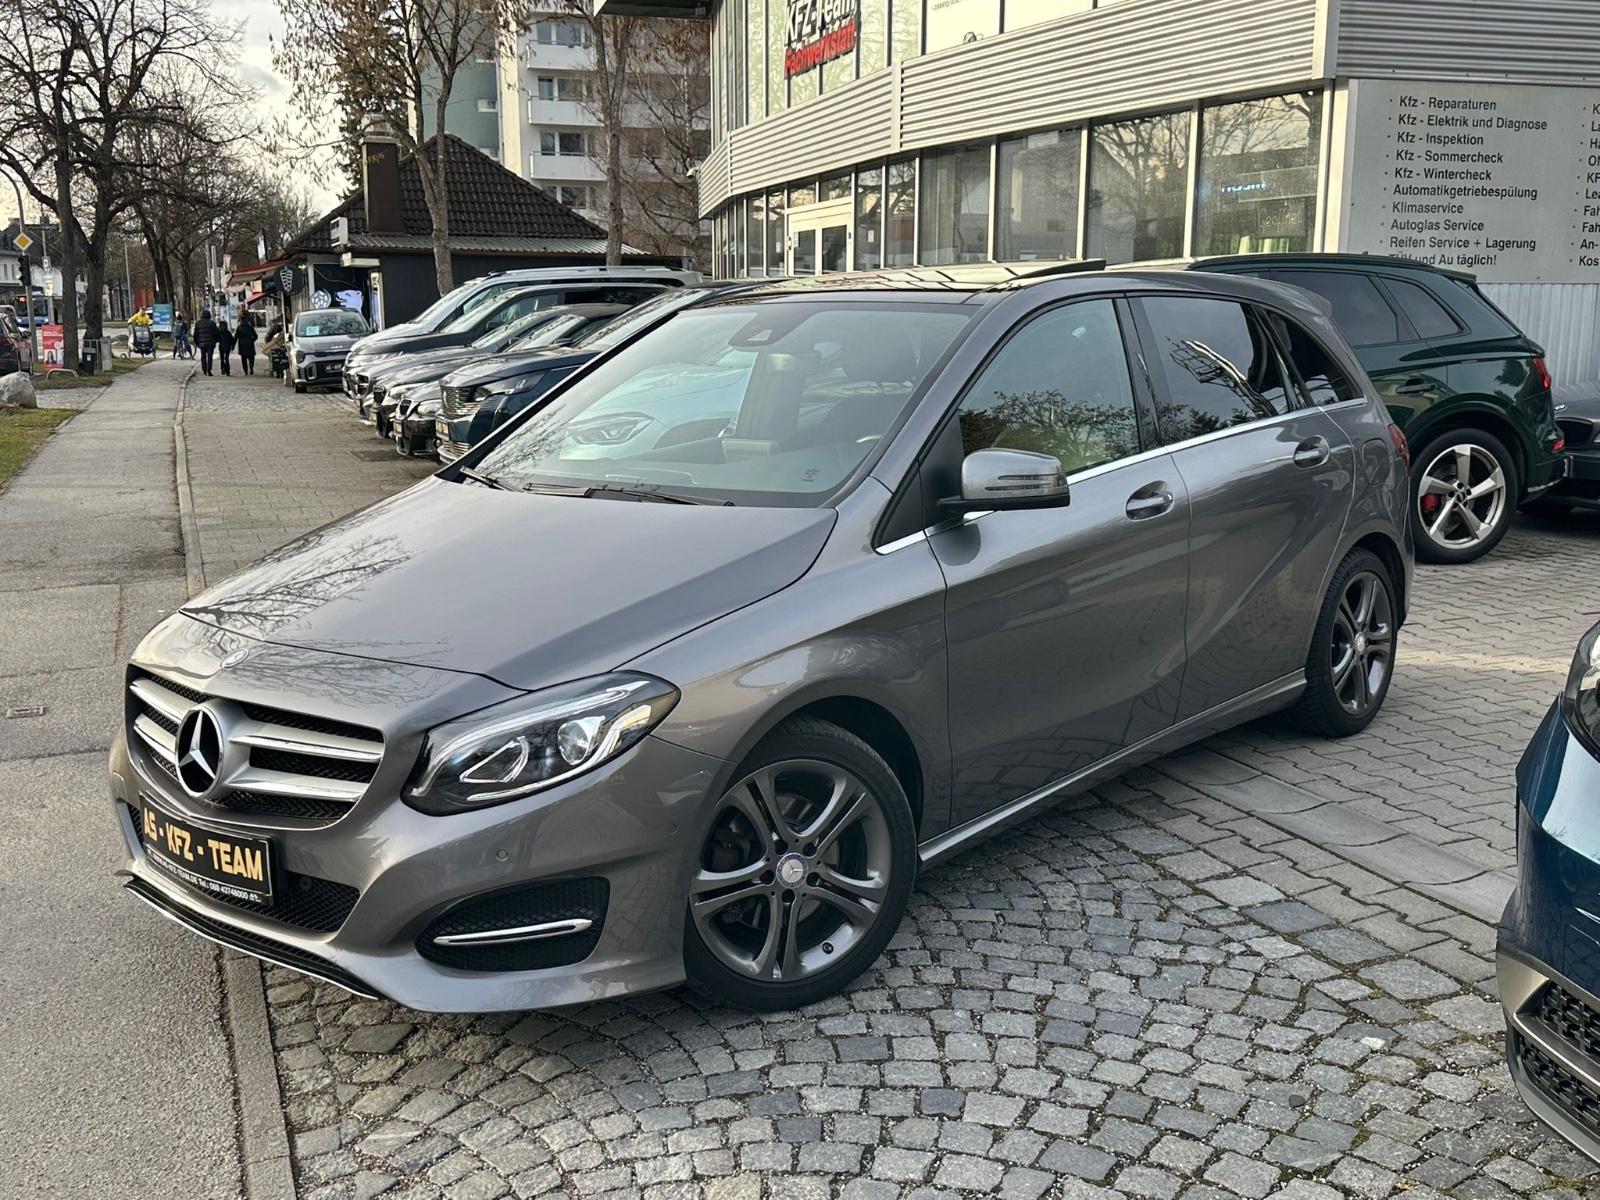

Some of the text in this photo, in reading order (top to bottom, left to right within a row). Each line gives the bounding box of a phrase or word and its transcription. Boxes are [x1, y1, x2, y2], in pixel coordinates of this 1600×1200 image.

[1400, 96, 1418, 107] Kfz
[1428, 97, 1496, 111] Reparaturen
[1398, 114, 1417, 125] Kfz
[1427, 115, 1469, 127] Elektrik
[1472, 117, 1493, 128] und
[1496, 117, 1547, 132] Diagnose
[1397, 131, 1416, 143] Kfz
[1426, 132, 1484, 147] Inspektion
[1396, 149, 1414, 161] Kfz
[1425, 150, 1503, 163] Sommercheck
[1395, 167, 1413, 179] Kfz
[1424, 168, 1491, 180] Wintercheck
[1393, 184, 1538, 200] Automatikgetriebespülung
[1392, 202, 1464, 214] Klimaservice
[1391, 219, 1484, 233] Autoglas Service
[1389, 236, 1425, 248] Reifen
[1429, 236, 1470, 248] Service
[1485, 237, 1537, 252] Lagerung
[1415, 254, 1436, 265] und
[1439, 254, 1454, 265] Au
[1457, 254, 1497, 268] täglich!
[143, 807, 158, 841] AS
[165, 821, 194, 862] KFZ
[207, 838, 264, 882] TEAM
